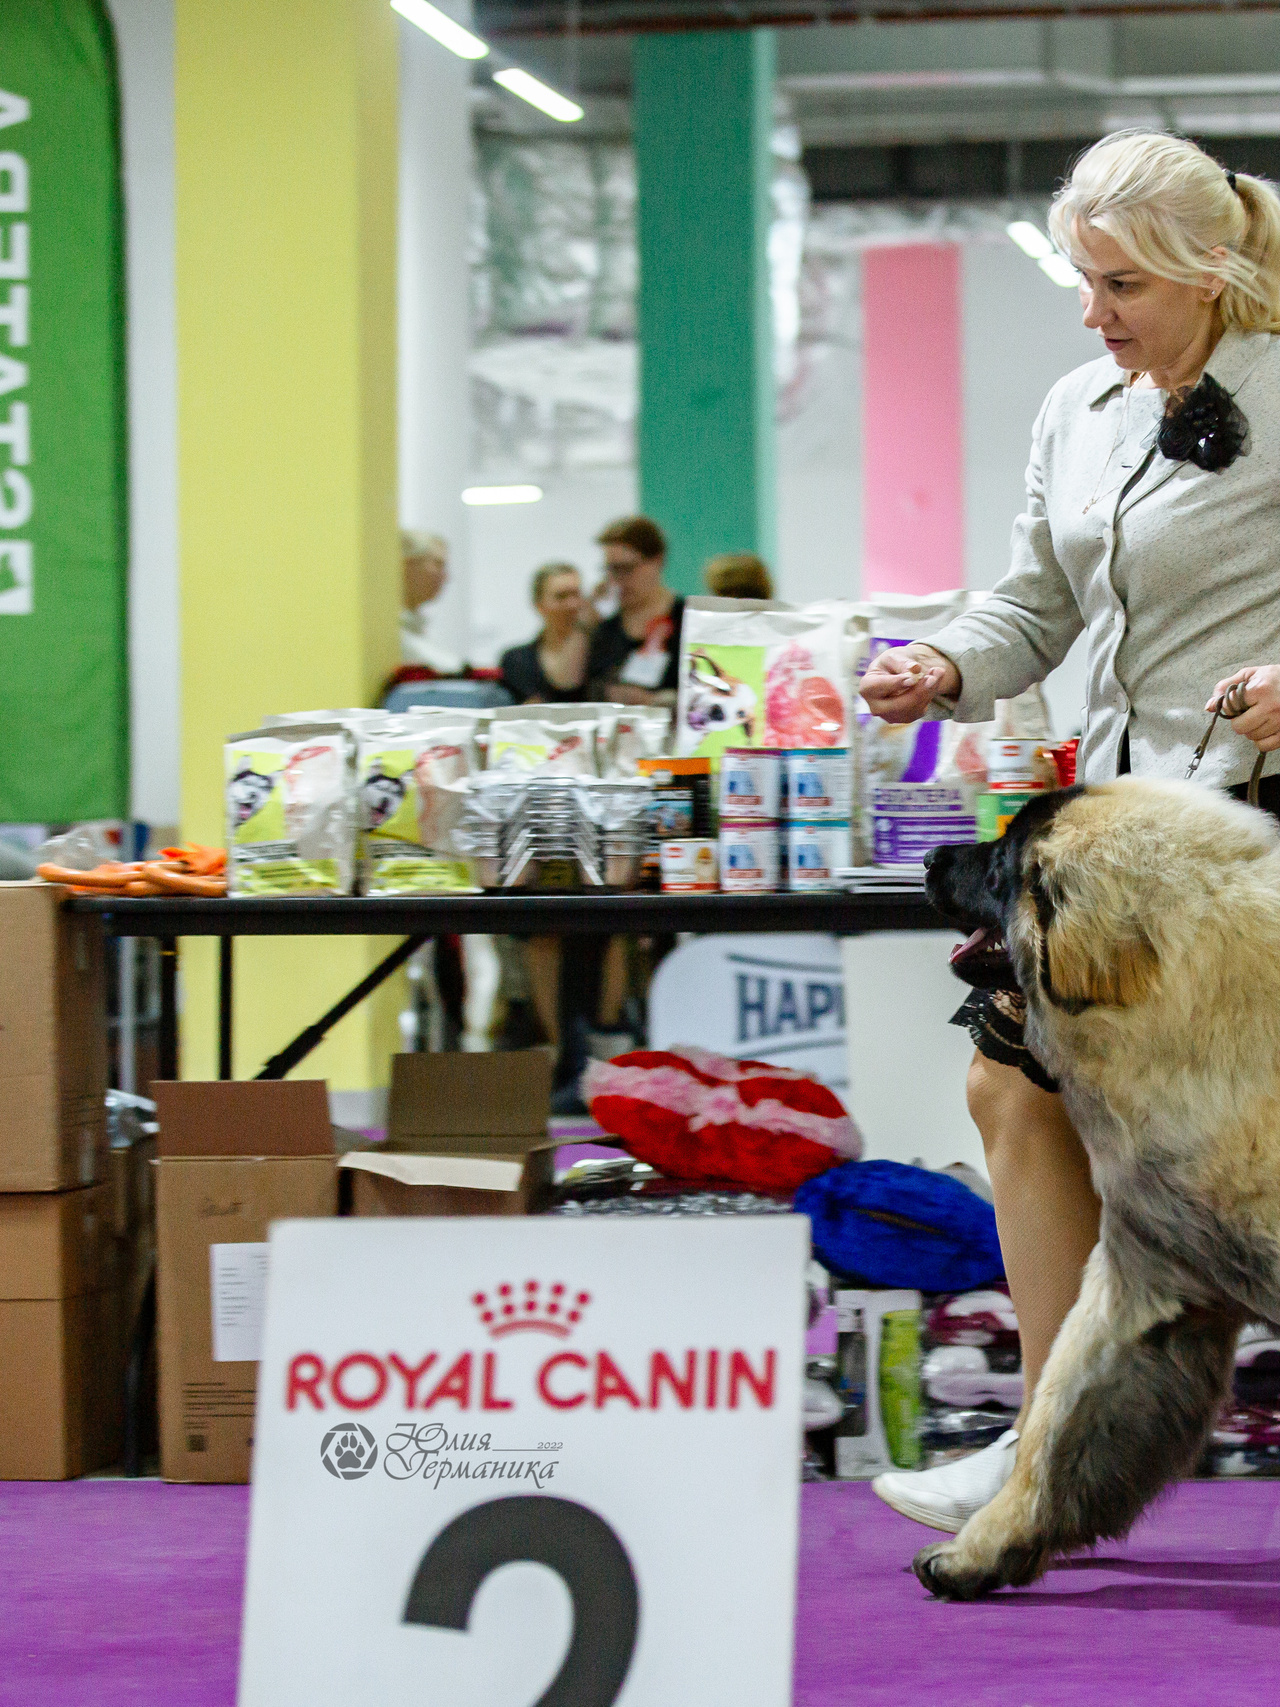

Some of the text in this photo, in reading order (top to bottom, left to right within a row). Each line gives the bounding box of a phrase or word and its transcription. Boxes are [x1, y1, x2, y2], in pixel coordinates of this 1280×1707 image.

[736, 973, 846, 1042] HAP
[286, 1350, 515, 1410] ROYAL
[536, 1348, 777, 1410] CANIN
[401, 1494, 641, 1707] 2
